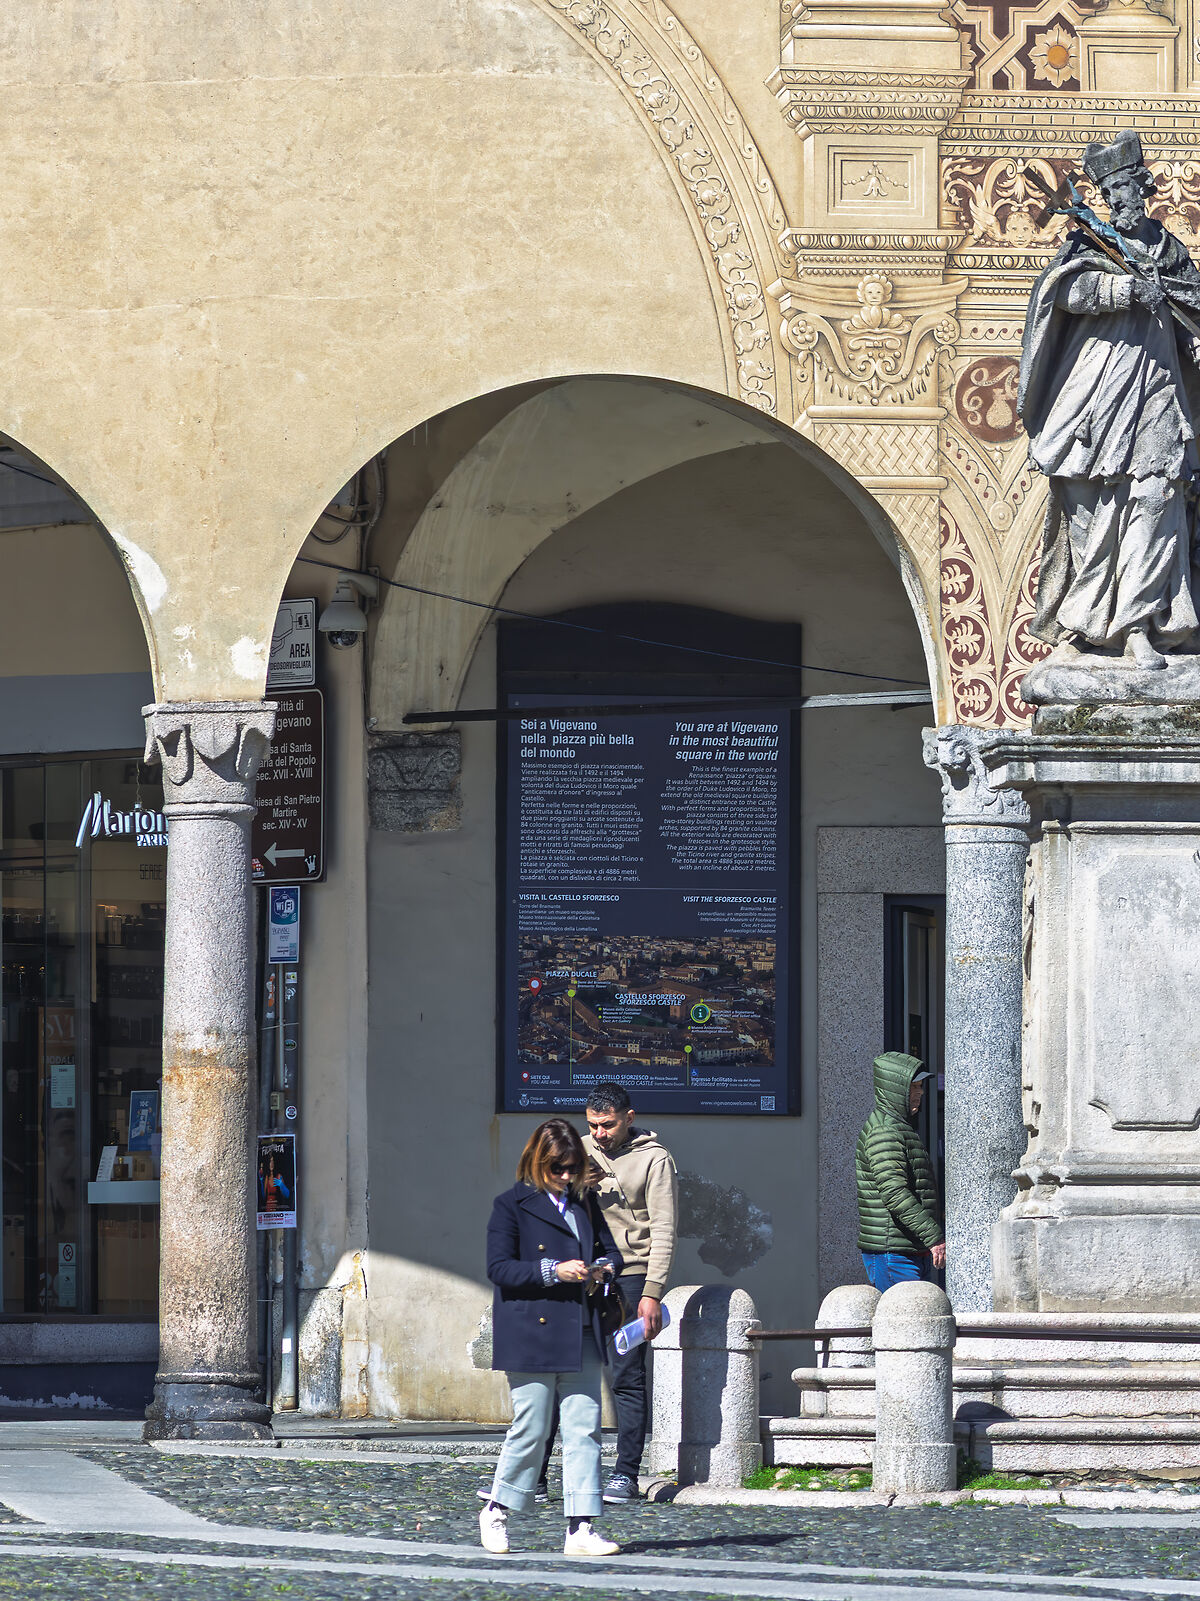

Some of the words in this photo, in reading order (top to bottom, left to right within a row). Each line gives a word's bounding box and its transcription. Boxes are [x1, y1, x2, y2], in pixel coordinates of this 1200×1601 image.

[289, 643, 311, 658] AREA
[270, 661, 311, 670] DEOSORVEGLIATA
[296, 700, 304, 711] di
[520, 719, 537, 730] Sei
[540, 721, 546, 730] a
[550, 719, 597, 732] Vigevano
[675, 722, 694, 732] You
[697, 723, 714, 732] are
[717, 722, 729, 732] at
[731, 722, 778, 734] Vigevano
[520, 733, 546, 744] nella
[552, 734, 586, 746] piazza
[589, 734, 605, 746] più
[609, 734, 634, 745] bella
[669, 735, 679, 745] in
[682, 735, 699, 746] the
[702, 736, 729, 746] most
[731, 736, 778, 747] beautiful
[280, 743, 288, 753] di
[290, 742, 312, 753] Santa
[520, 747, 536, 758] del
[540, 748, 576, 758] mondo
[260, 757, 273, 767] aria
[275, 756, 287, 767] del
[289, 755, 316, 767] Popolo
[675, 750, 712, 762] square
[715, 749, 725, 760] in
[728, 749, 745, 760] the
[748, 750, 778, 760] world
[581, 763, 599, 771] piazza
[256, 771, 271, 781] sec.
[273, 769, 288, 780] XVII
[295, 768, 313, 779] XVIII
[254, 797, 273, 807] hiesa
[275, 796, 281, 805] di
[284, 795, 297, 805] San
[299, 794, 320, 805] Pietro
[273, 807, 297, 818] Martire
[262, 822, 277, 830] sec.
[279, 819, 291, 829] XIV
[297, 818, 308, 828] XV
[136, 834, 169, 847] PARIS
